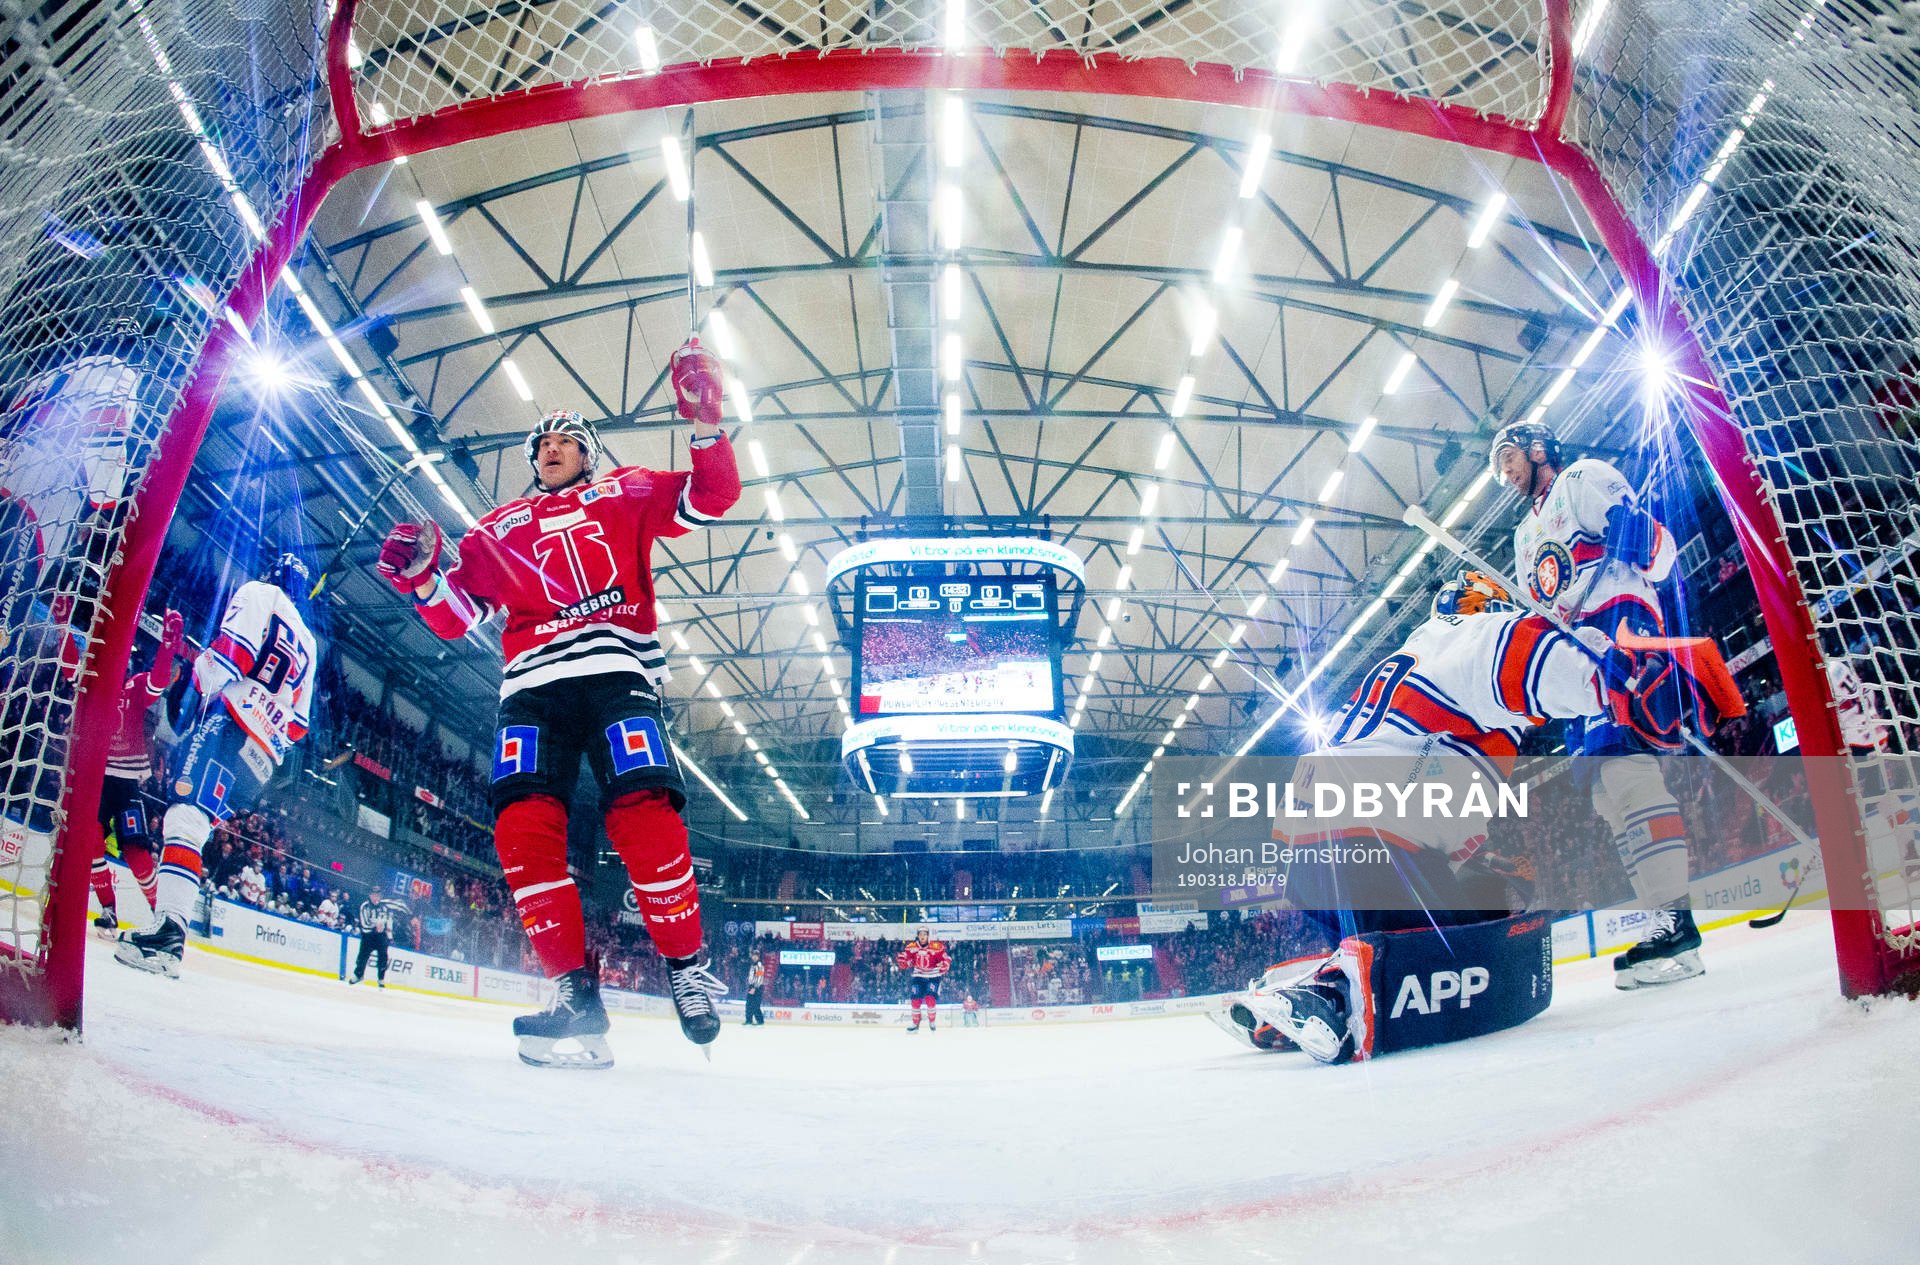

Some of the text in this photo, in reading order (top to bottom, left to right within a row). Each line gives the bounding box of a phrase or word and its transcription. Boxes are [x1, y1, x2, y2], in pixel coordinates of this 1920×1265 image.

[496, 513, 530, 532] rebro
[910, 545, 921, 555] Vi
[976, 546, 994, 556] en
[997, 544, 1069, 561] klimatsmar
[560, 590, 622, 618] ÖREBRO
[252, 707, 286, 756] INTERSPO
[1704, 875, 1761, 909] bravida
[256, 924, 287, 946] Prinfo
[430, 965, 463, 984] PEAB
[1391, 966, 1490, 1019] APP
[1091, 1005, 1114, 1016] TAM
